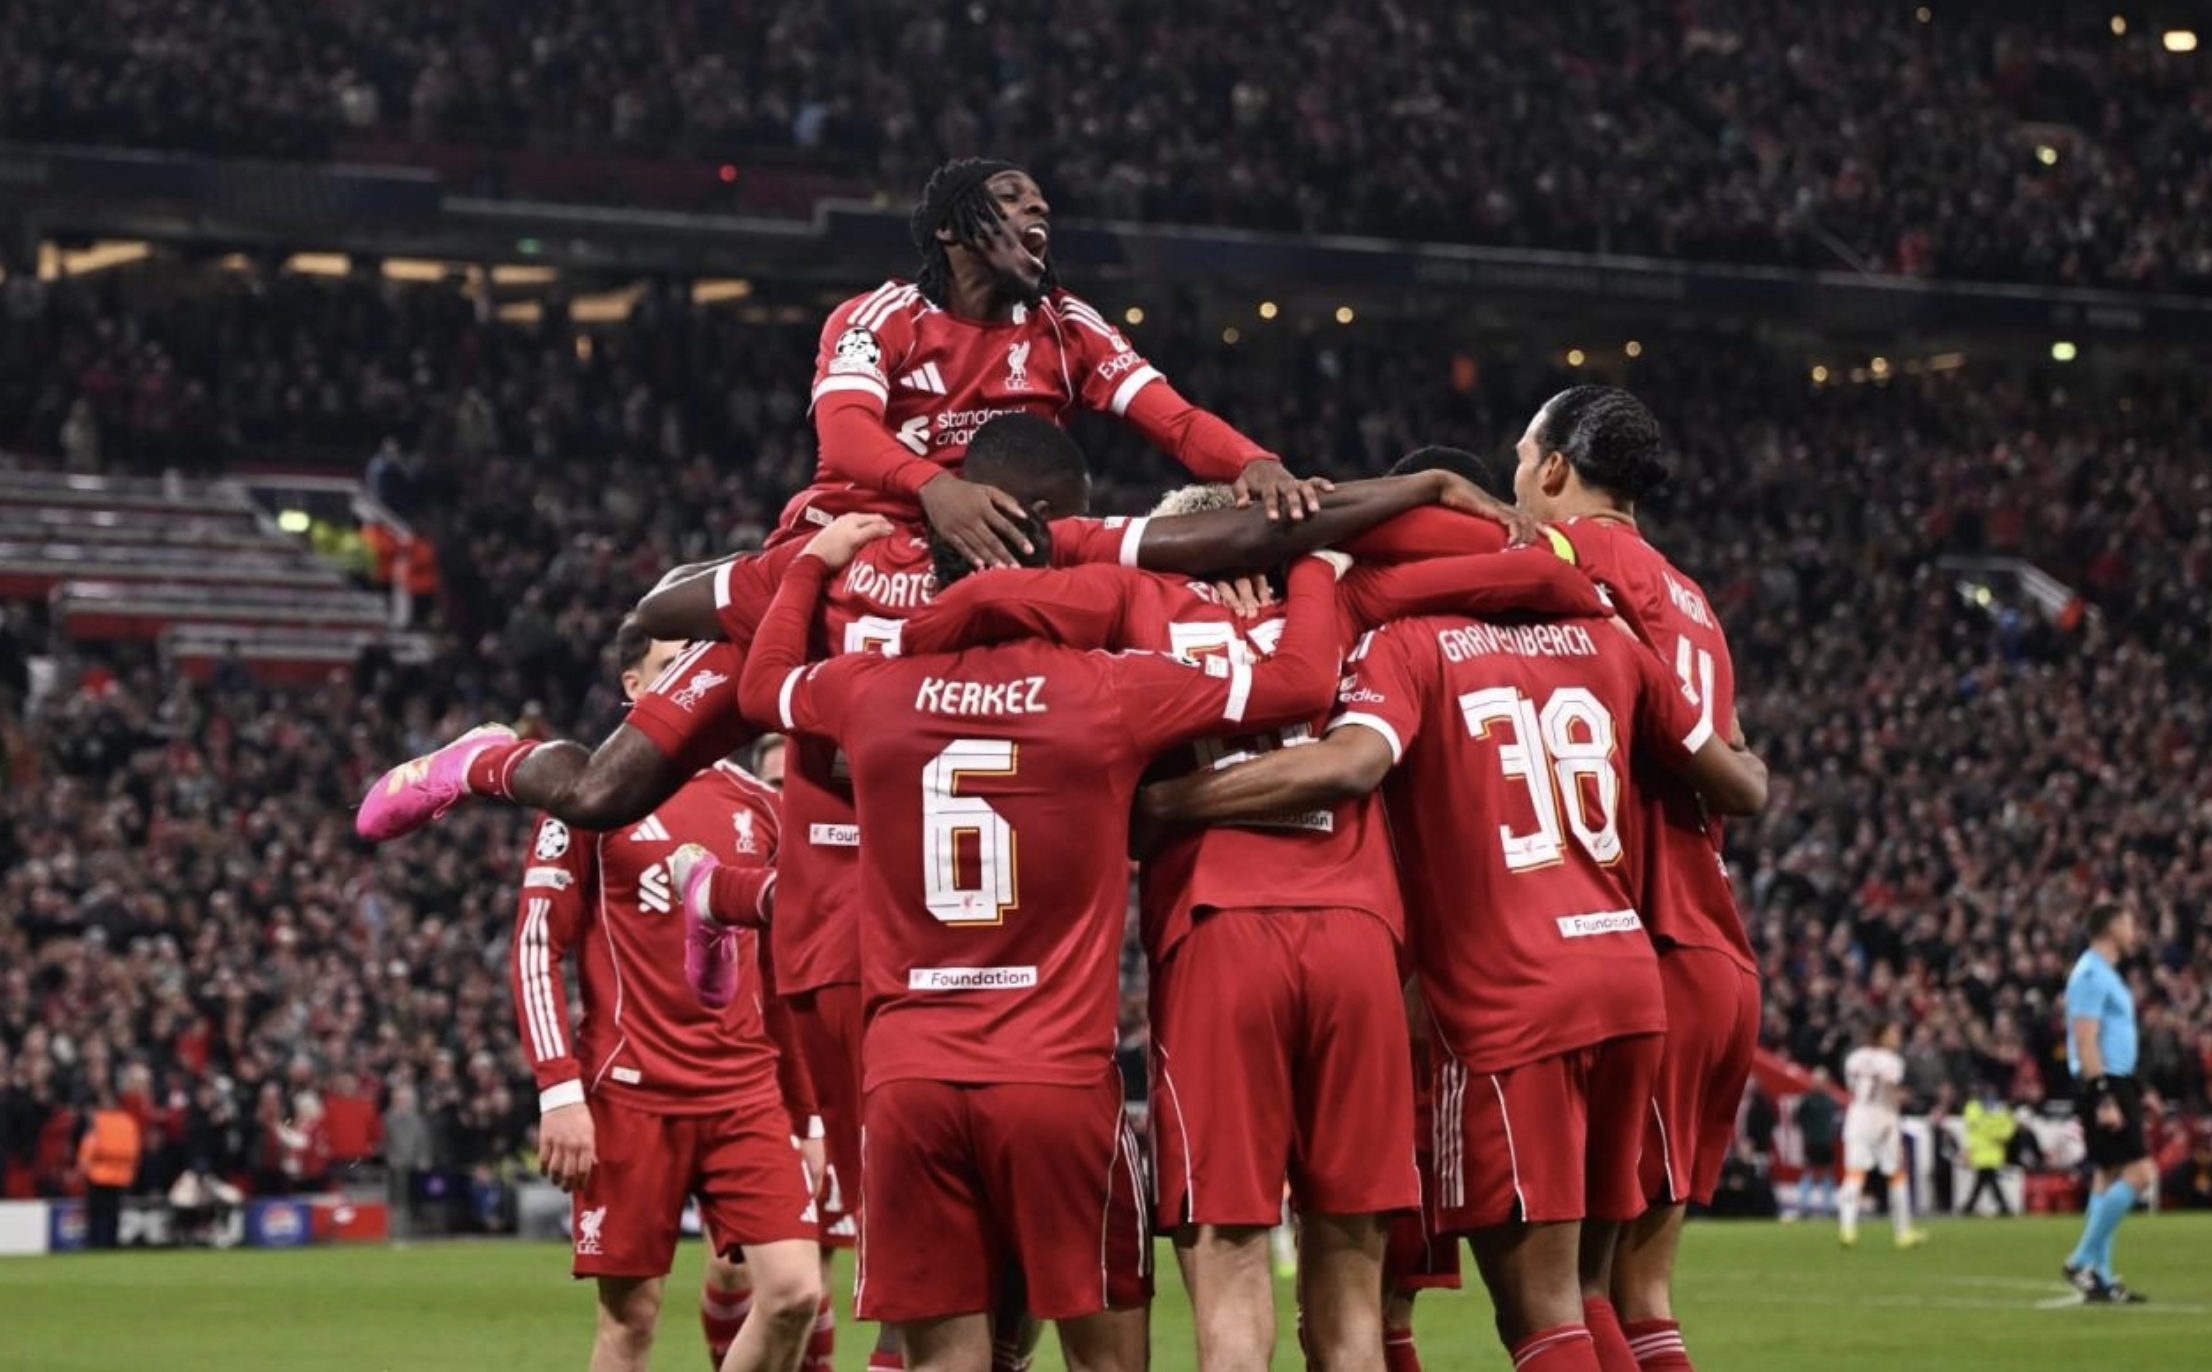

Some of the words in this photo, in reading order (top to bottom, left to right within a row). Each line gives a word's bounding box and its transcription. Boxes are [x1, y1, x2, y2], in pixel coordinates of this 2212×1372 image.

[915, 676, 1047, 715] KERKEZ
[922, 739, 1018, 926] 6
[1458, 686, 1622, 873] 38
[930, 971, 1031, 987] Foundation
